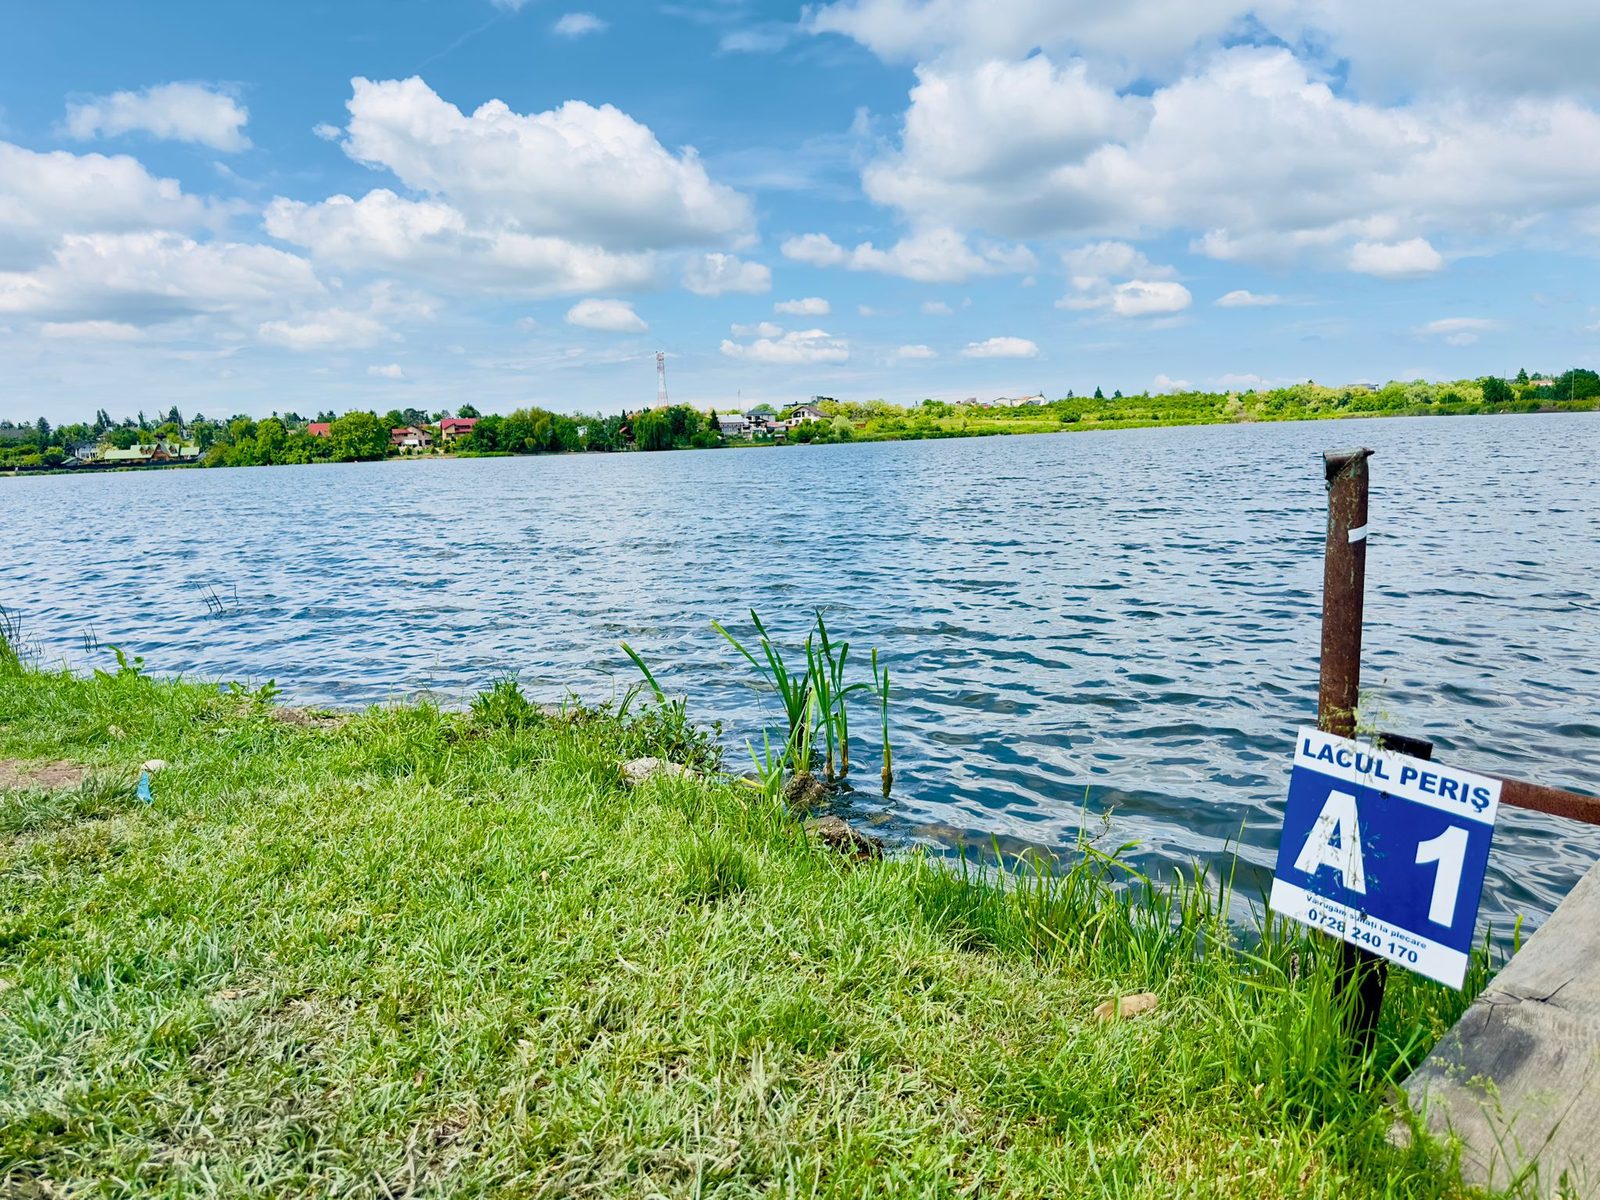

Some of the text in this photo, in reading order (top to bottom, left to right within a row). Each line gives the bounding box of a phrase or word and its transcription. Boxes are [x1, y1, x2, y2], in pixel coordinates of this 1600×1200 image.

[1302, 738, 1390, 780] LACUL
[1293, 789, 1469, 928] A 1
[1308, 908, 1418, 964] 0728 240 170
[1380, 924, 1388, 934] la
[1391, 930, 1427, 949] plecare
